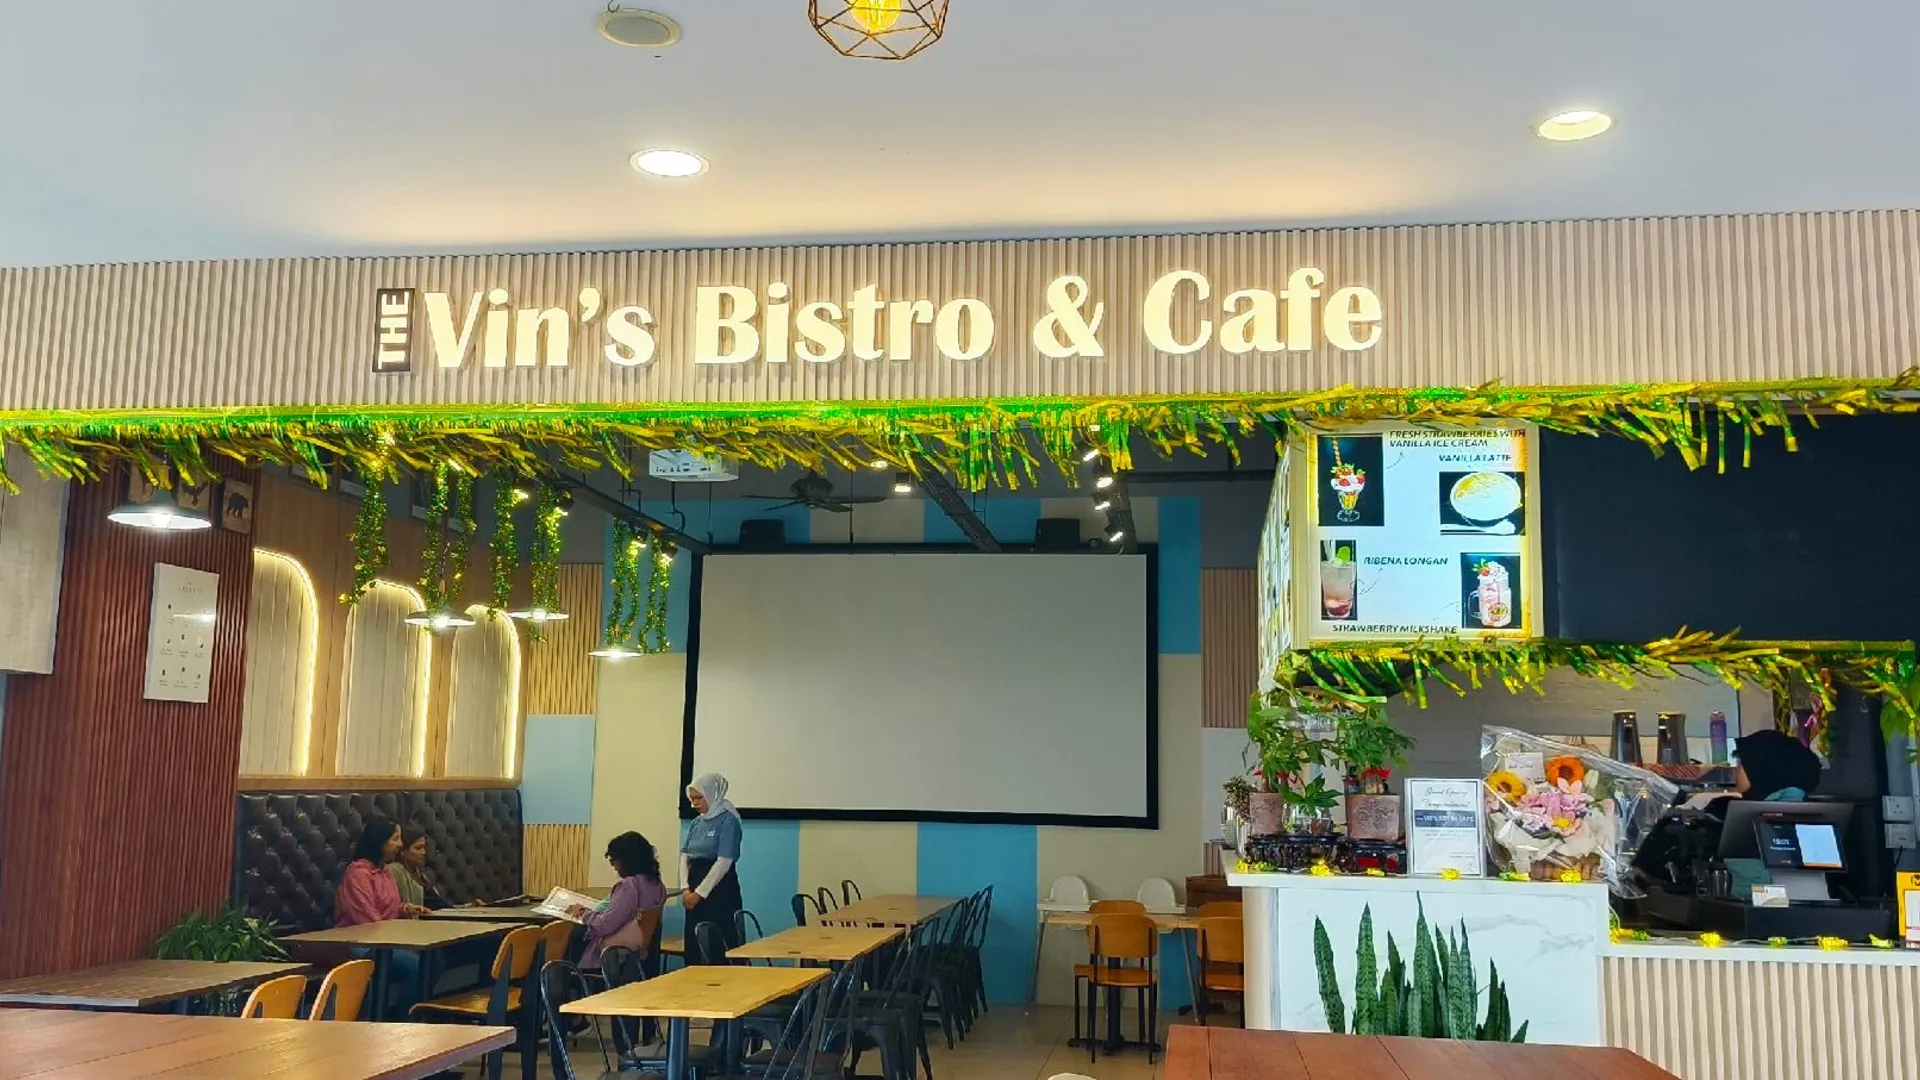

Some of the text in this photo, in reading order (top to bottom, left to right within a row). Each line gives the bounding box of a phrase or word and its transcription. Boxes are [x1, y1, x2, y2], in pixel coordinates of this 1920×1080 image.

[424, 267, 1383, 367] Vin's Bistro & Cafe
[378, 291, 410, 370] THE
[1389, 428, 1526, 439] FRESH STRAWBERRIES WITH
[1389, 438, 1488, 448] VANILLA ICE CREAM
[1438, 453, 1512, 462] VANILLA LATTE
[1363, 556, 1448, 566] RIBENA LONGAN
[1332, 623, 1459, 635] STRAWBERRY MILKSHAKE
